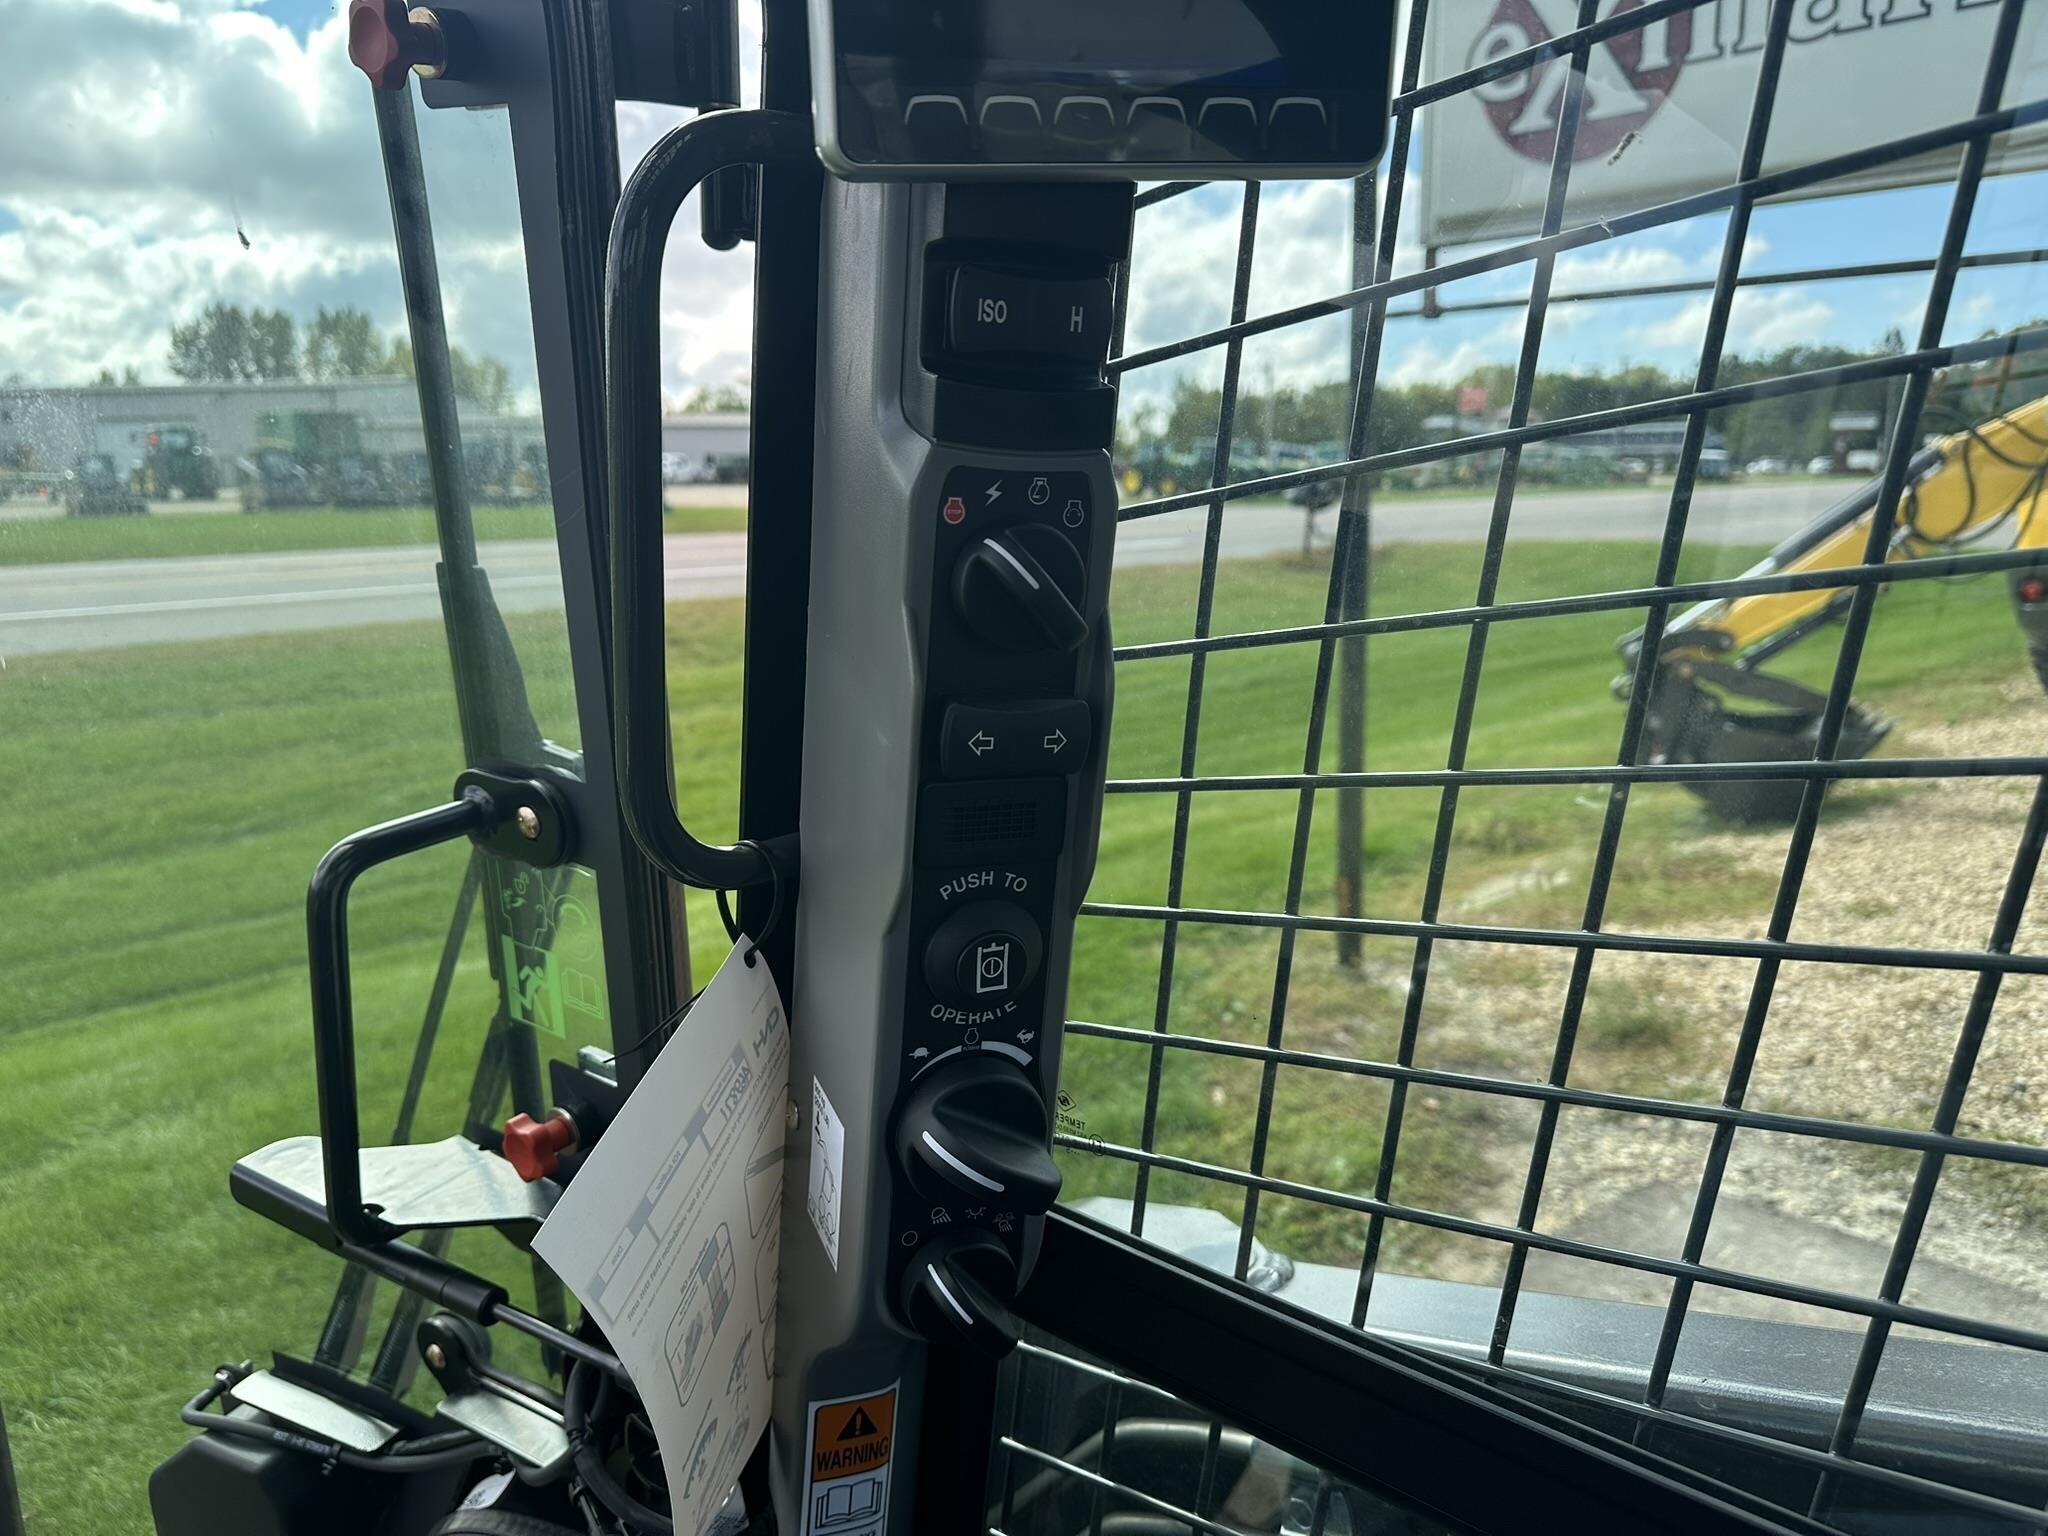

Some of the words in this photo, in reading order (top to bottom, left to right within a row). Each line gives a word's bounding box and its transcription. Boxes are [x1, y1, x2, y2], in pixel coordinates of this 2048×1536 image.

[977, 298, 1008, 324] ISO
[1069, 305, 1084, 333] H
[939, 871, 994, 900] PUSH
[1004, 872, 1028, 892] TO
[817, 1437, 889, 1472] WARNING
